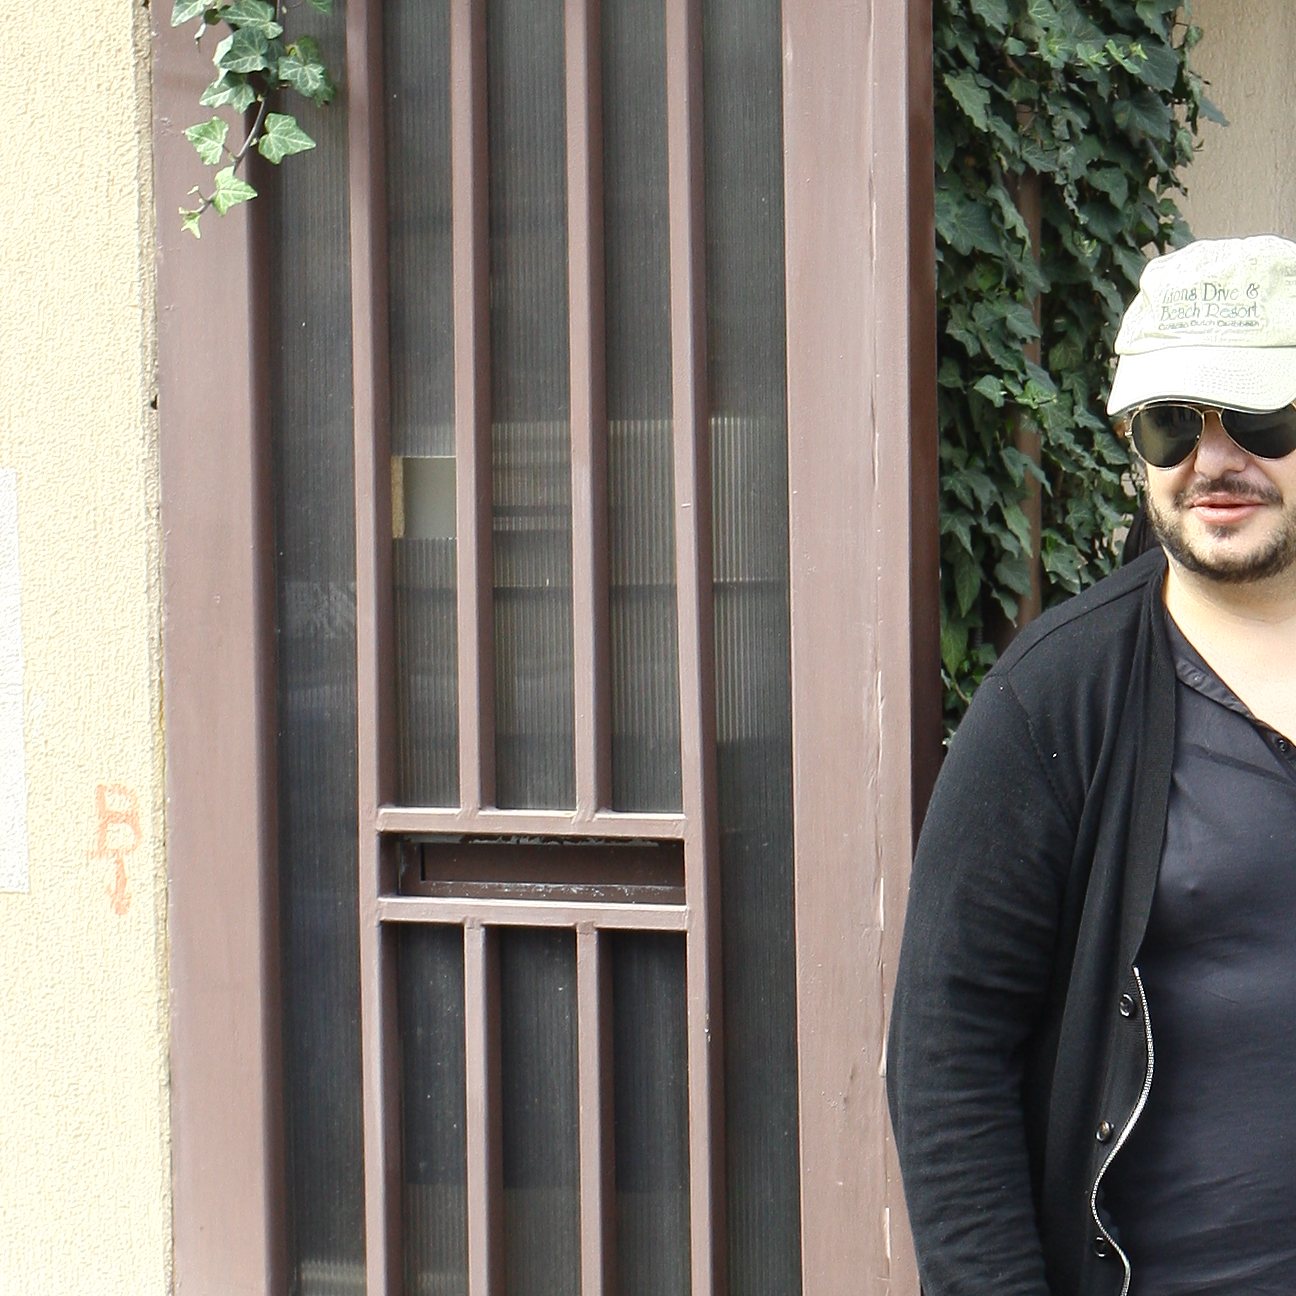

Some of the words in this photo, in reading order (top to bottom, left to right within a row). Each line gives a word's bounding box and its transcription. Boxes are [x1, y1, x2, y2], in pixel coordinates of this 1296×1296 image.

[1203, 282, 1239, 301] Dive
[1246, 282, 1260, 299] &
[1160, 302, 1200, 321] Beach
[1205, 301, 1260, 318] Resort
